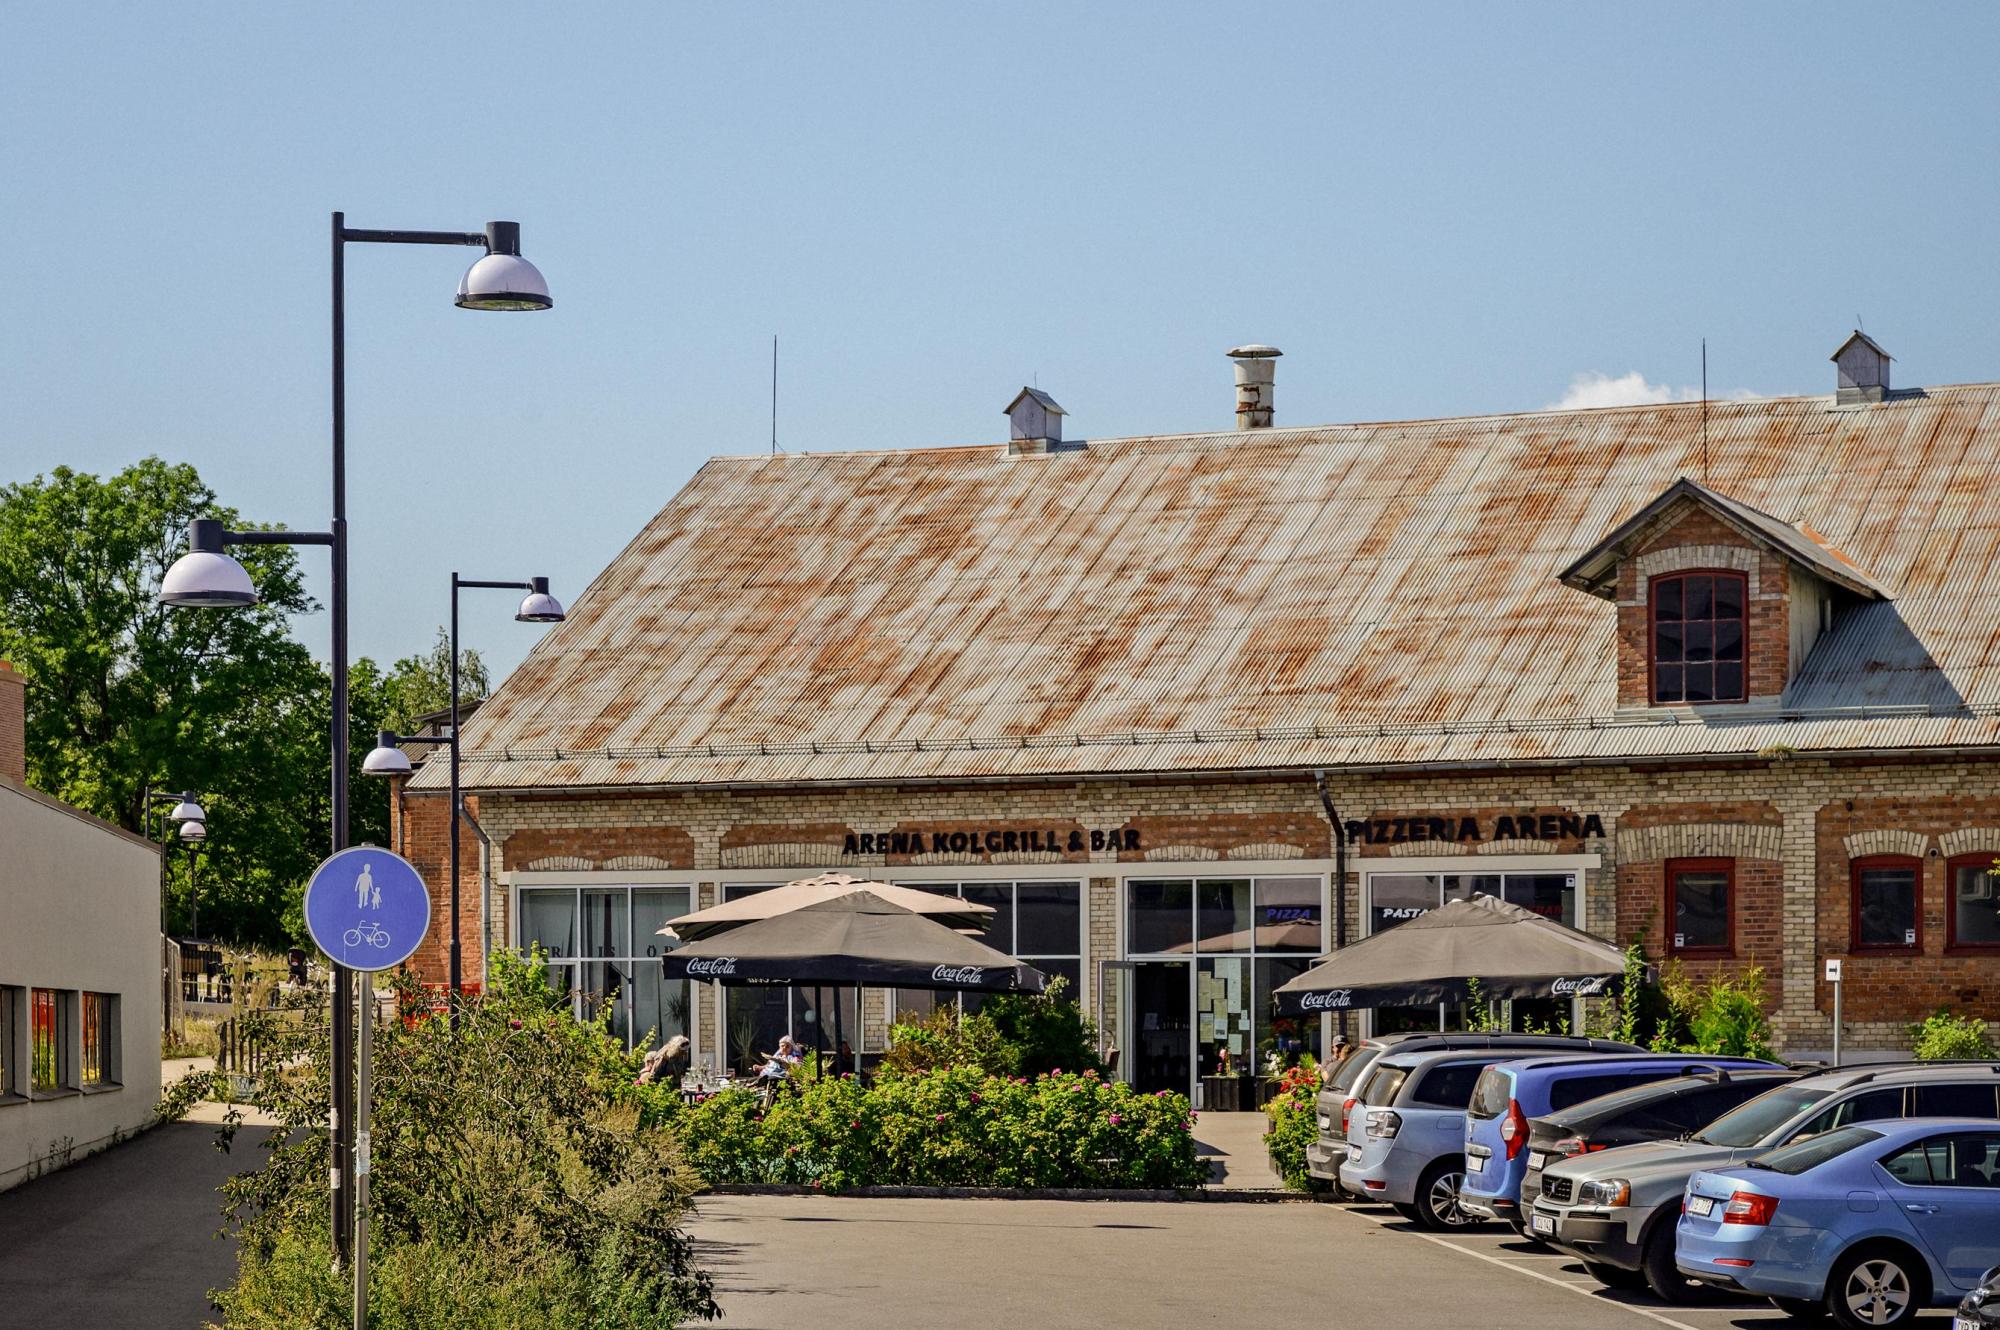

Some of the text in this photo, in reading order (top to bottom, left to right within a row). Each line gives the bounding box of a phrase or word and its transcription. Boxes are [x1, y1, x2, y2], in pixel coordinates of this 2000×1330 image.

[1344, 814, 1606, 844] PIZZERIA ARENA
[843, 829, 1141, 855] ARENA KOLGRILL & BAR
[1266, 908, 1312, 920] PIZZA
[686, 957, 738, 975] Coca-Cola
[931, 964, 984, 984] Coca-Cola
[1300, 989, 1353, 1010] Coca-Cola
